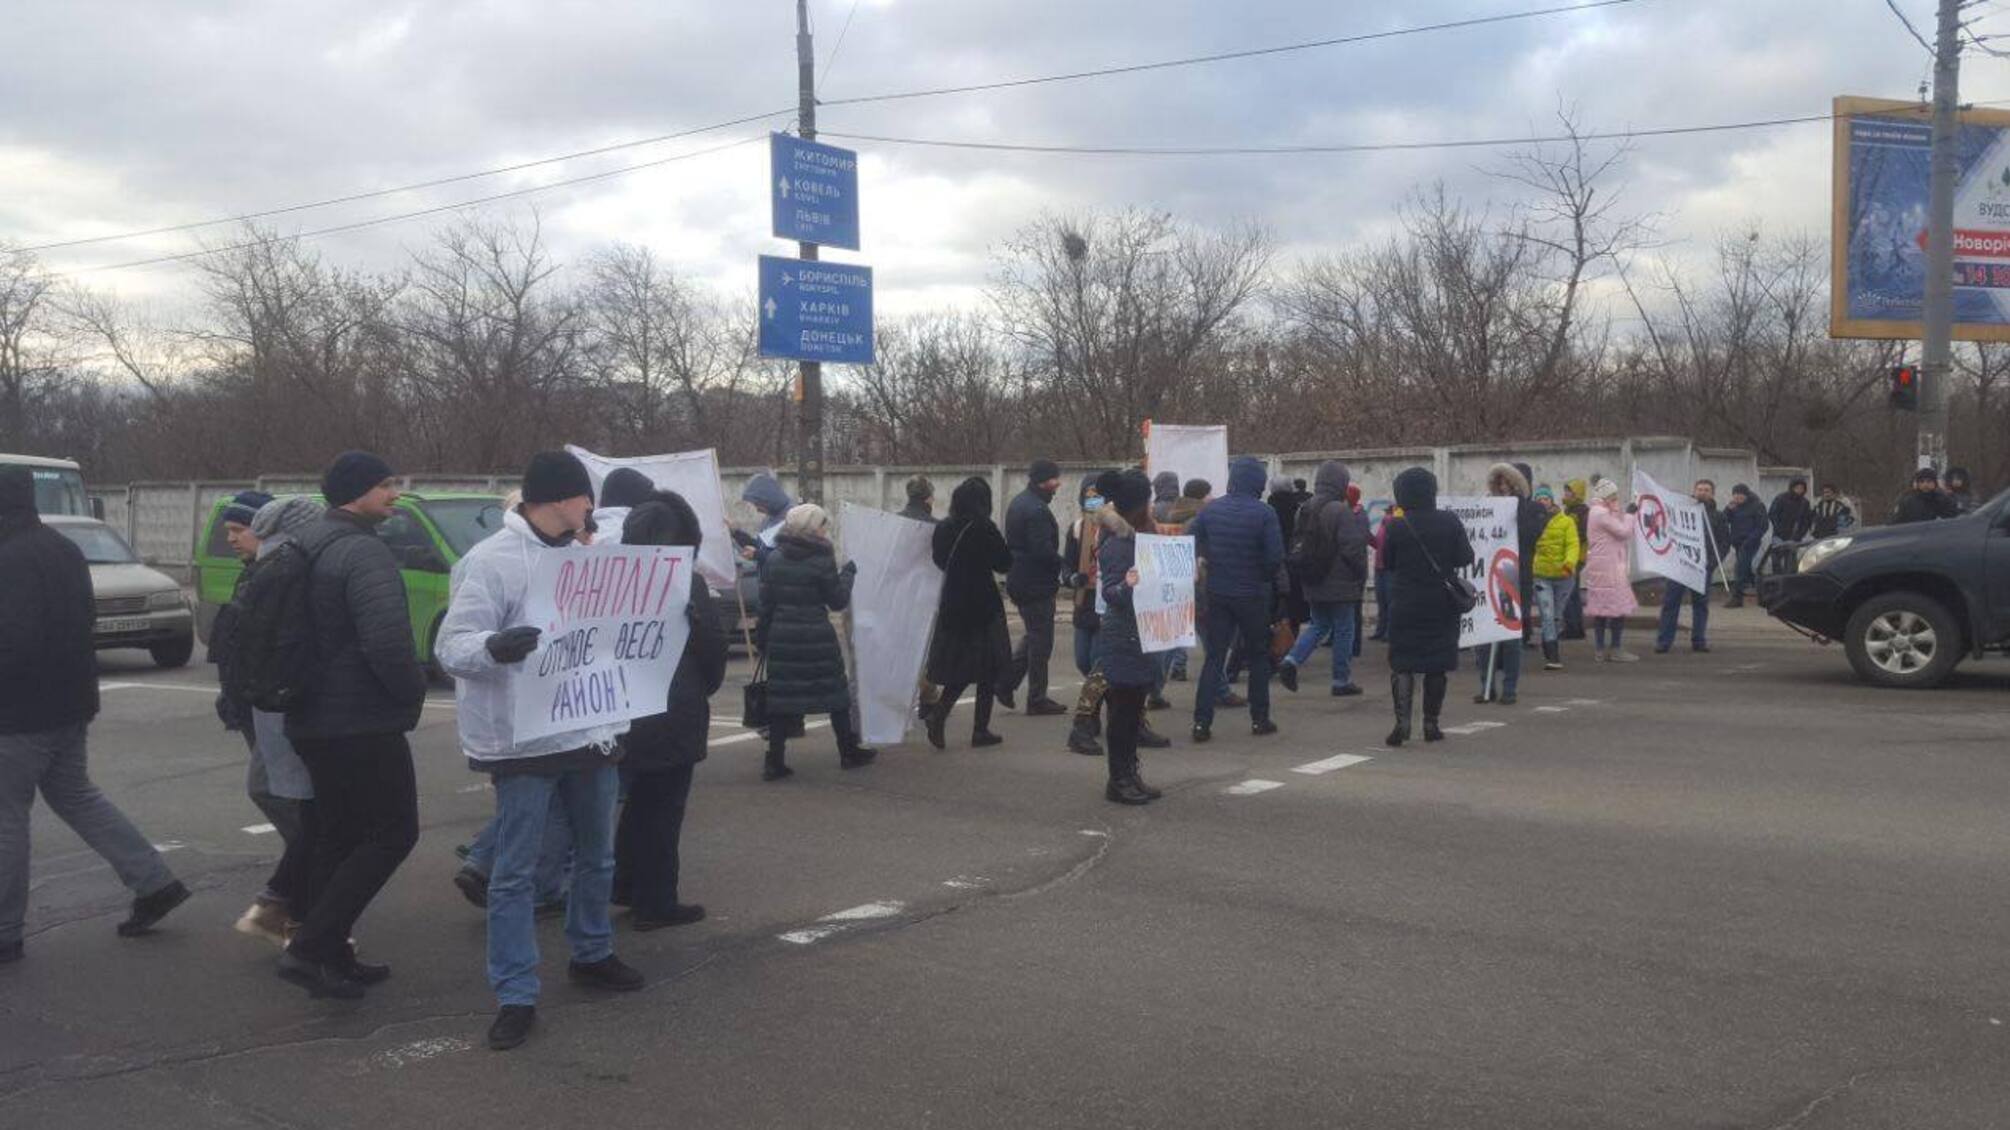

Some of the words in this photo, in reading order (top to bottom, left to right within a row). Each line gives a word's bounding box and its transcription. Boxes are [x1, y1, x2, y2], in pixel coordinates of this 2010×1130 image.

[794, 148, 857, 171] ЖИТОМИР
[795, 178, 841, 198] КОВЕЛЬ
[799, 270, 868, 288] БОРИСПІЛЬ
[800, 301, 850, 316] ХАРКІВ
[801, 330, 864, 345] ДОНЕЦЬК
[555, 547, 682, 625] ФАНПЛІТ
[614, 621, 666, 660] ВЕСЬ
